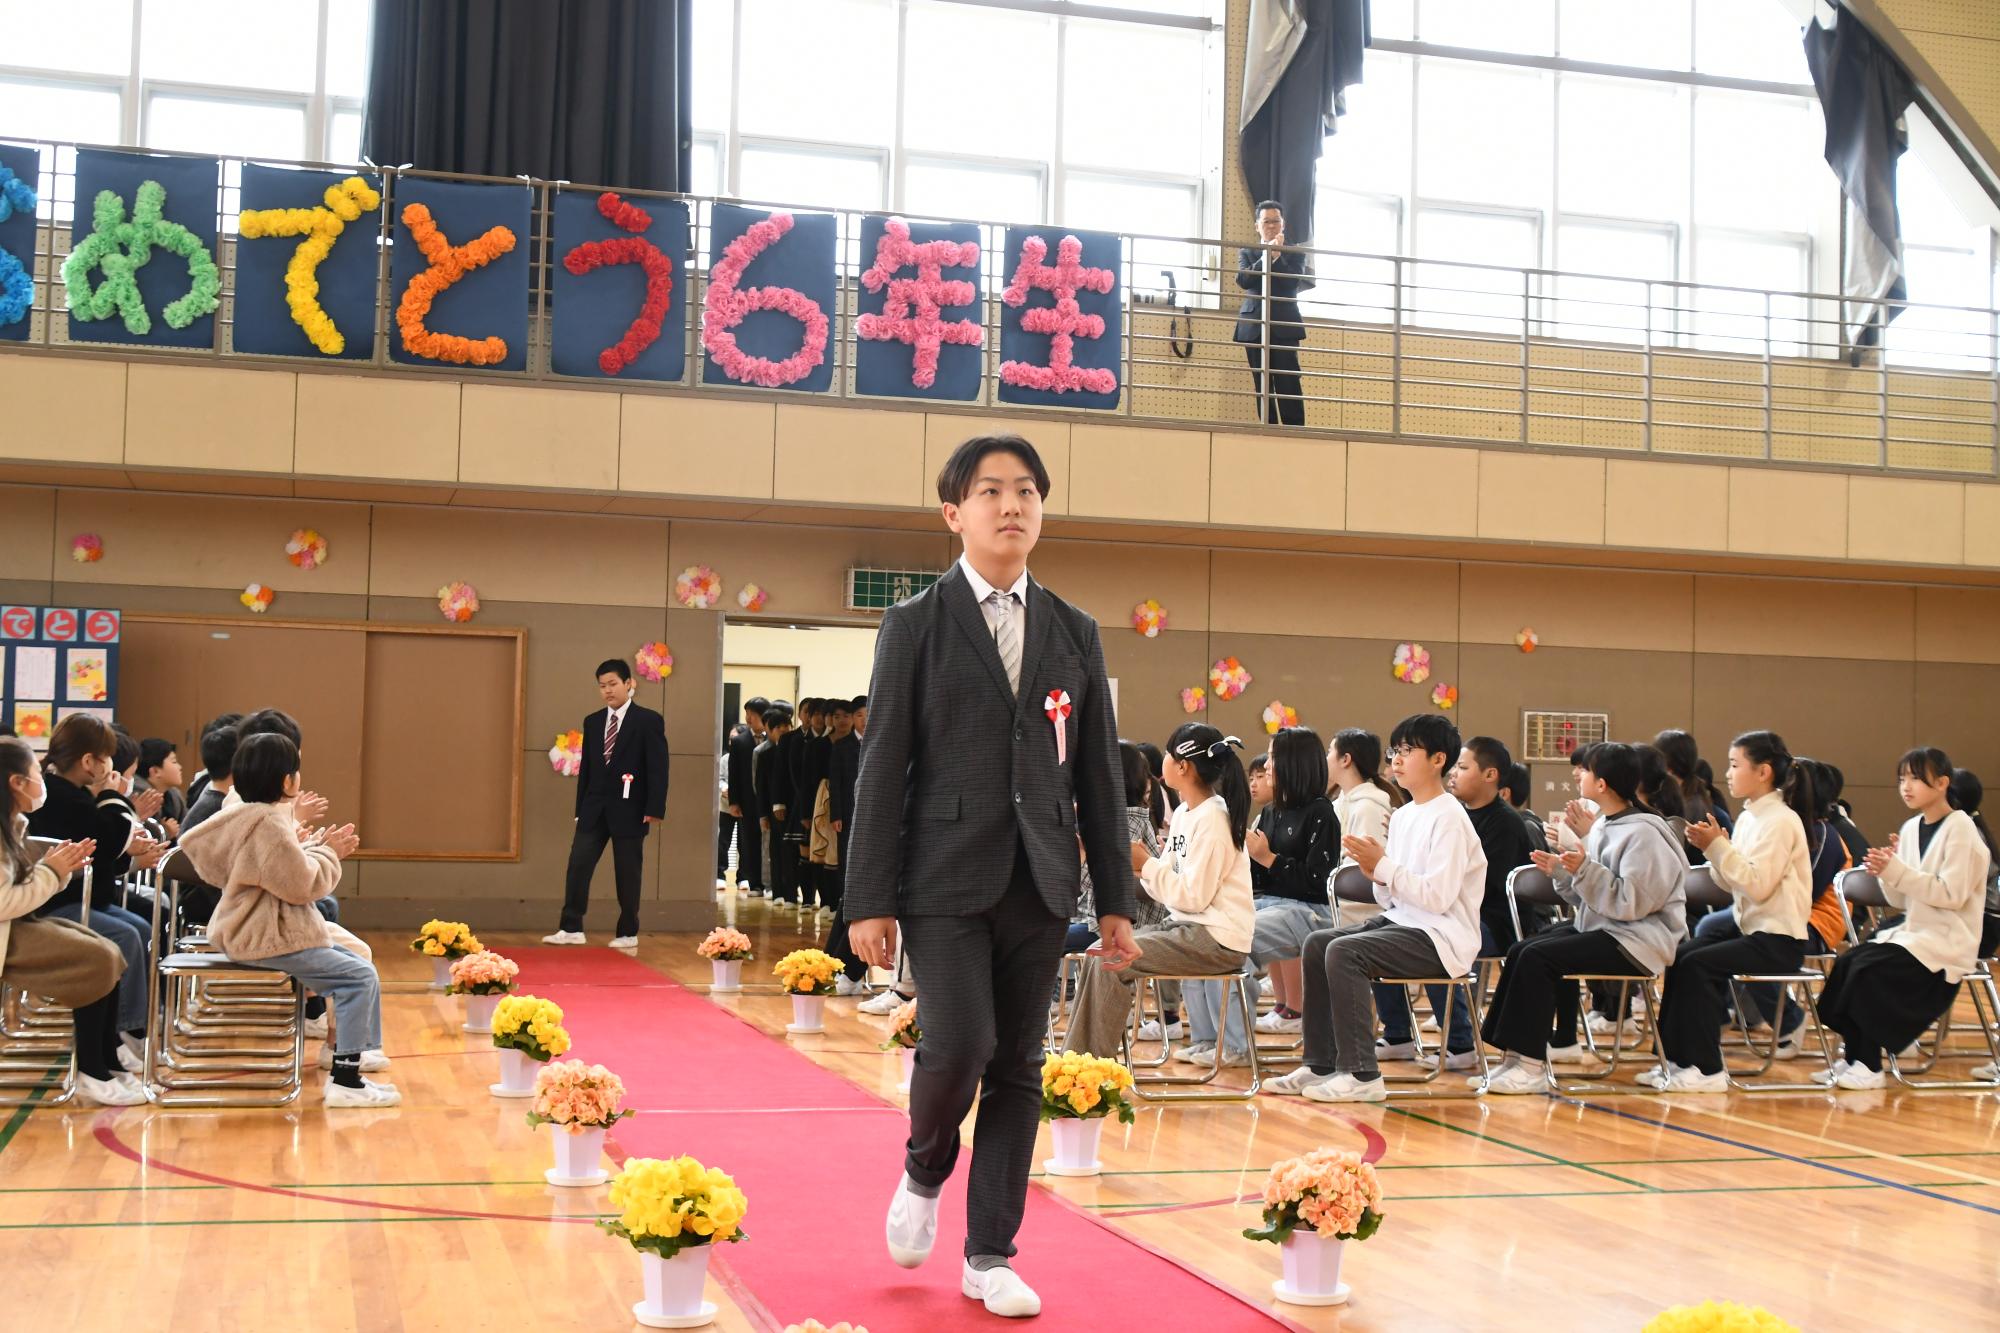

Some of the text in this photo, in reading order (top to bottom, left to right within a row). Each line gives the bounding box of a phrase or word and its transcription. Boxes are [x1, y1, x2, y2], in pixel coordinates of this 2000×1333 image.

[0, 161, 1117, 394] めでとう6年生
[7, 613, 114, 637] でとう
